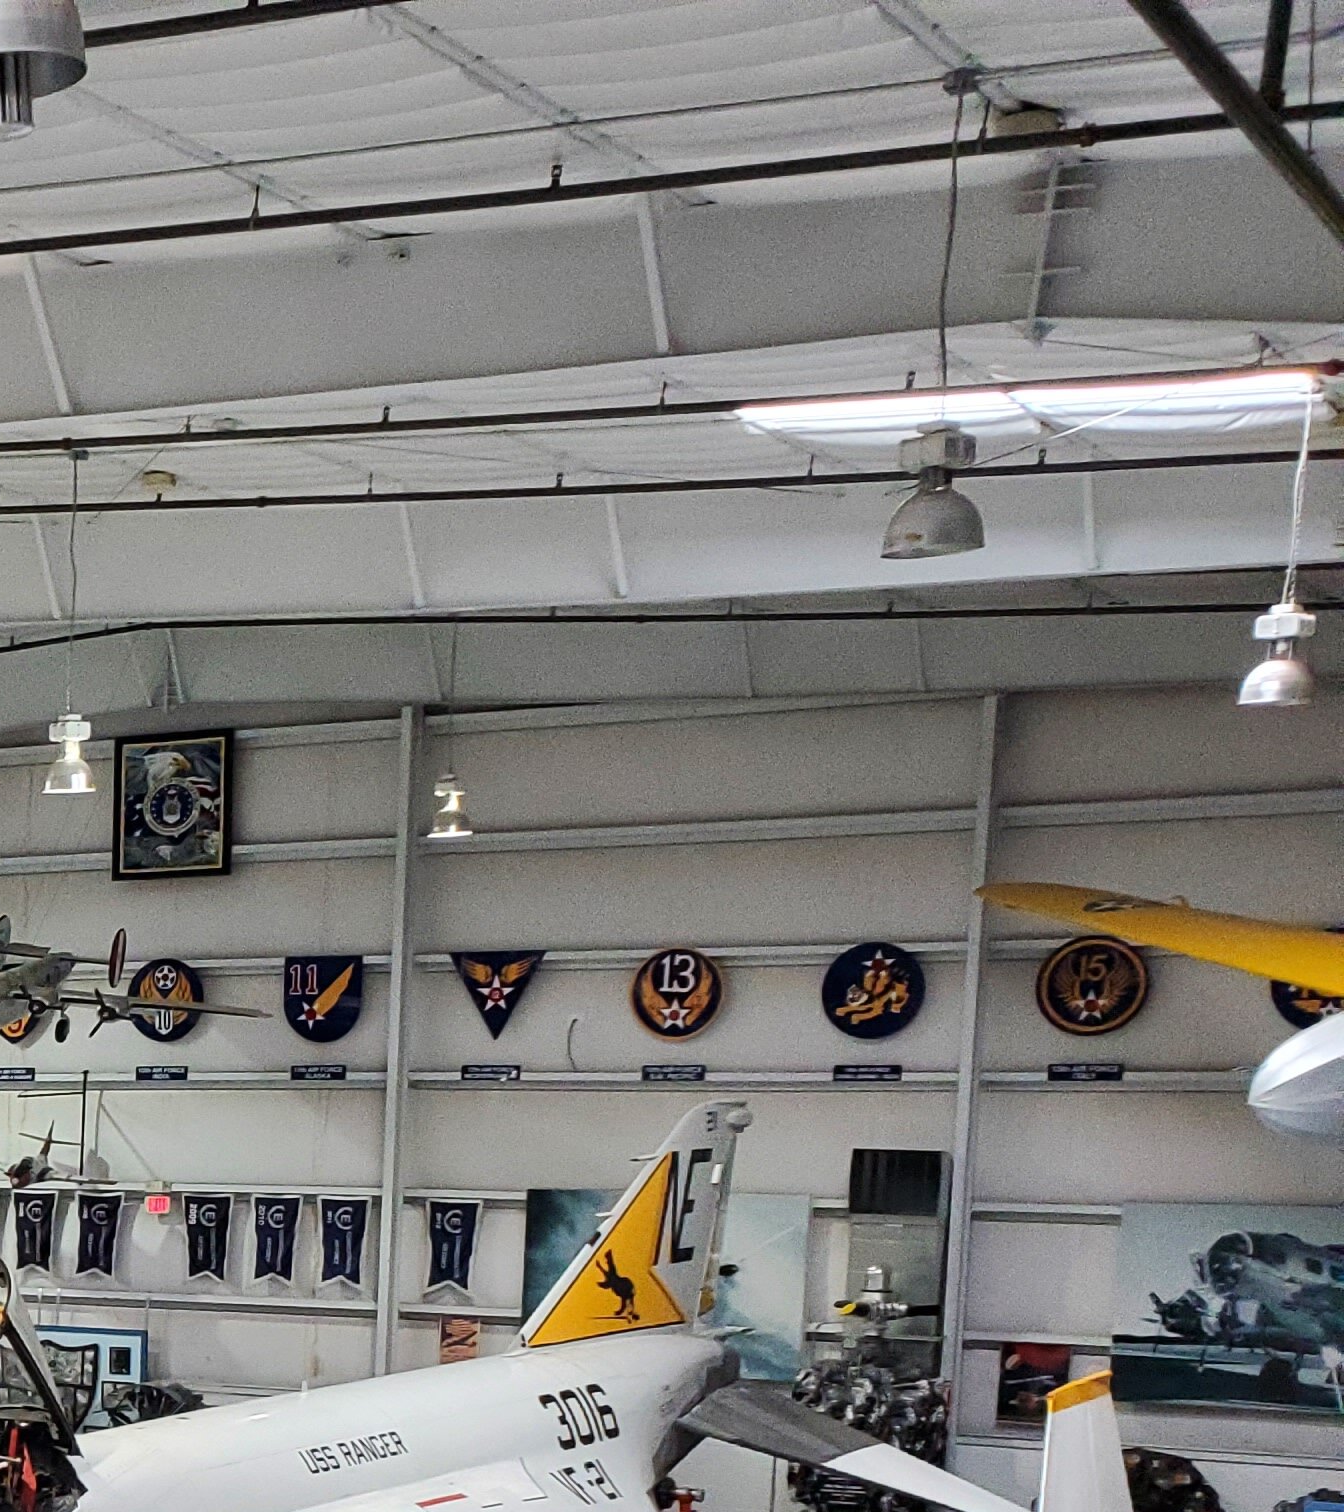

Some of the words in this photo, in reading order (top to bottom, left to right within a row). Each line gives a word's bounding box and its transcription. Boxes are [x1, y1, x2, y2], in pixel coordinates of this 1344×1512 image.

[289, 964, 319, 995] 11
[659, 954, 696, 993] 13
[538, 1383, 620, 1450] 3016
[297, 1444, 339, 1475] USS
[340, 1430, 410, 1467] RANGER
